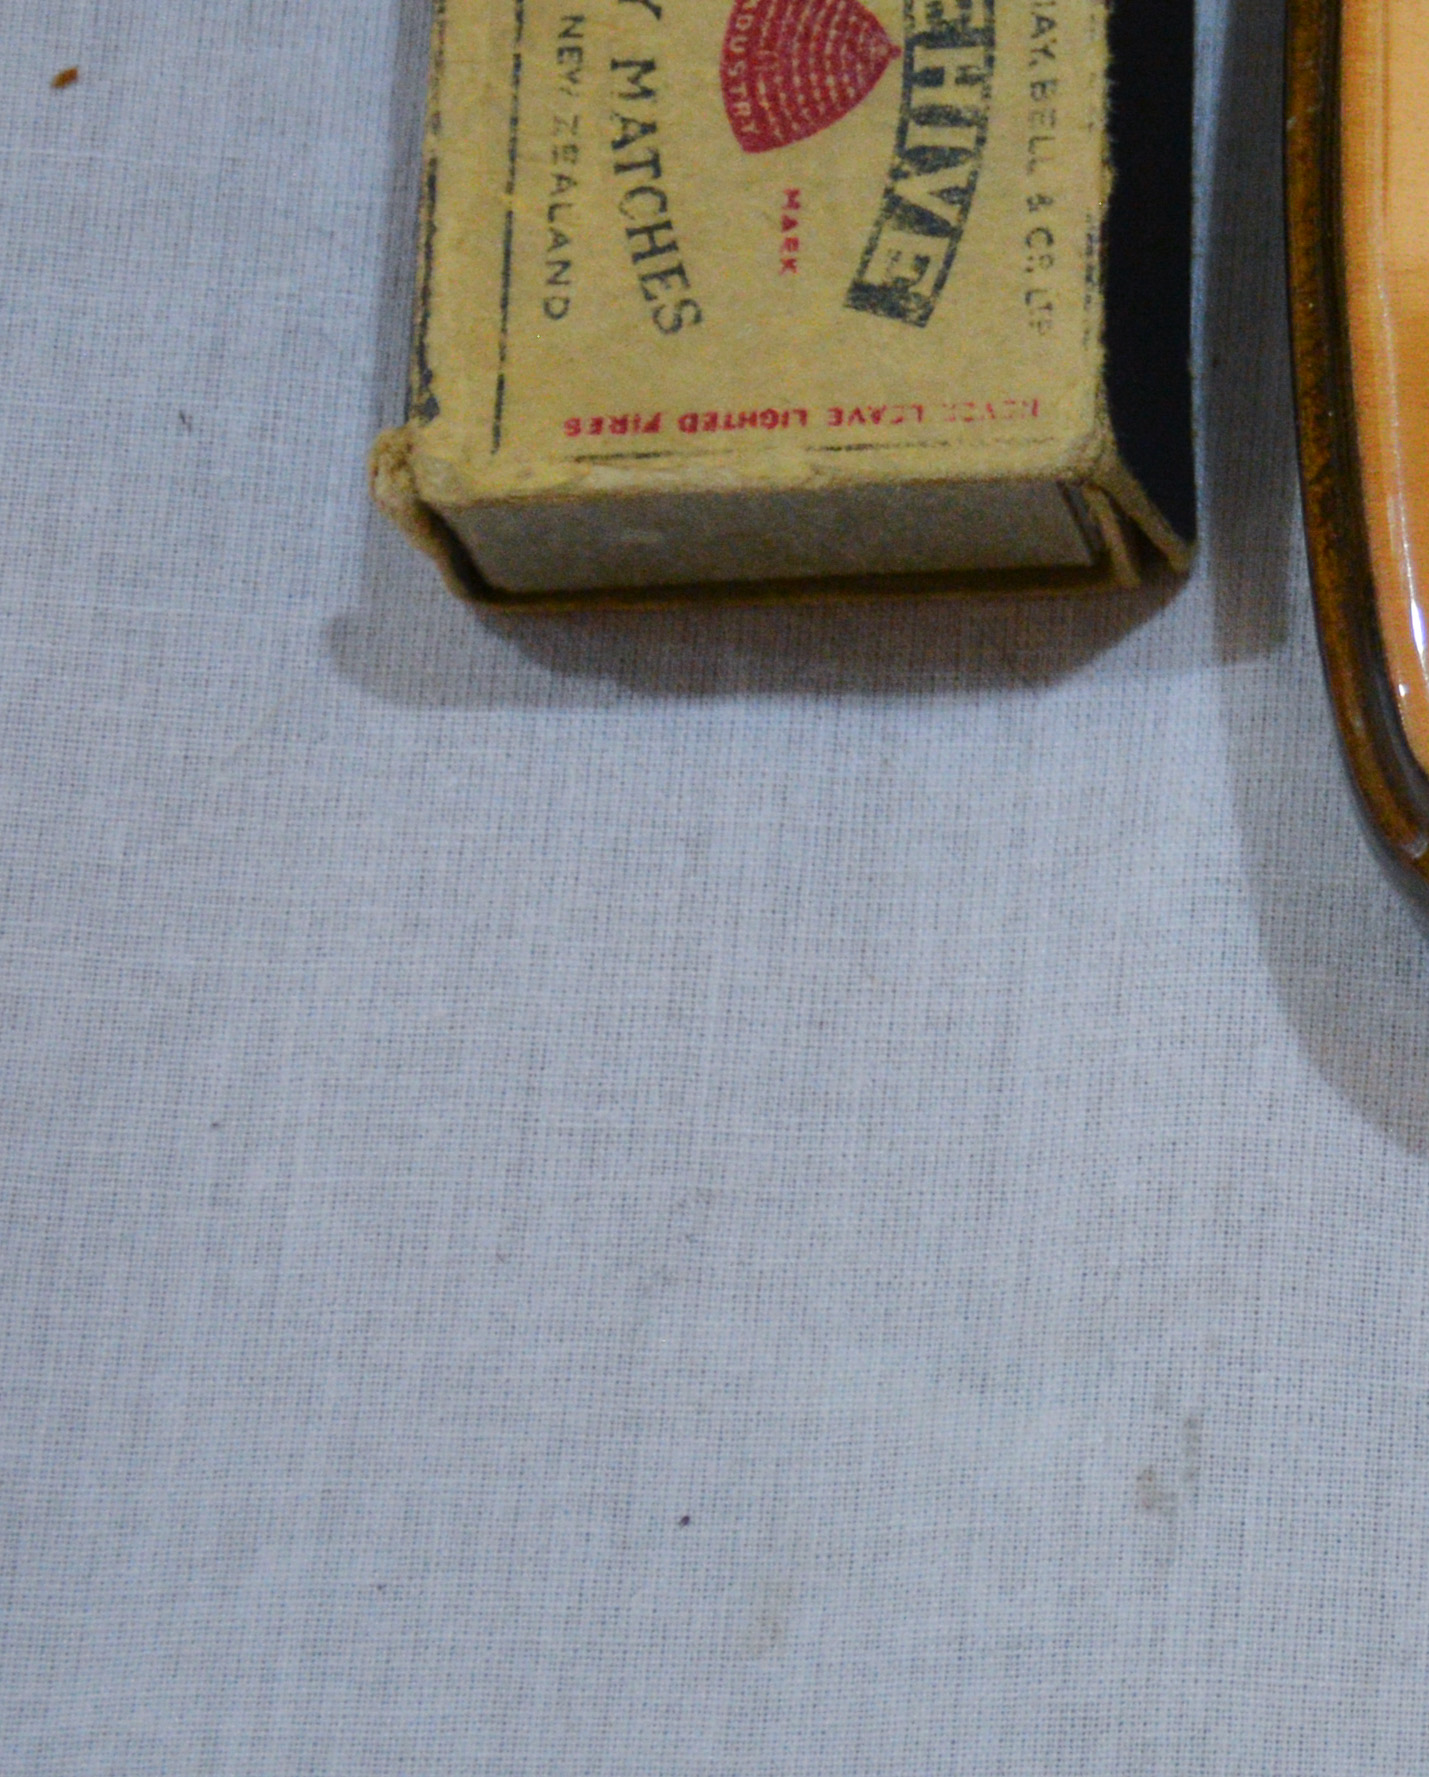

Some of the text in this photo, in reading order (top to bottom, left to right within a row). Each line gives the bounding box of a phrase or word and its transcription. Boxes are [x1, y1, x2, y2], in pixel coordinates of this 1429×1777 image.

[555, 14, 584, 96] NEW
[543, 113, 581, 322] ZEALAND
[610, 56, 704, 337] MATCHES
[779, 187, 801, 276] MARK
[562, 411, 663, 438] FIRES
[678, 407, 809, 434] LIGHTED
